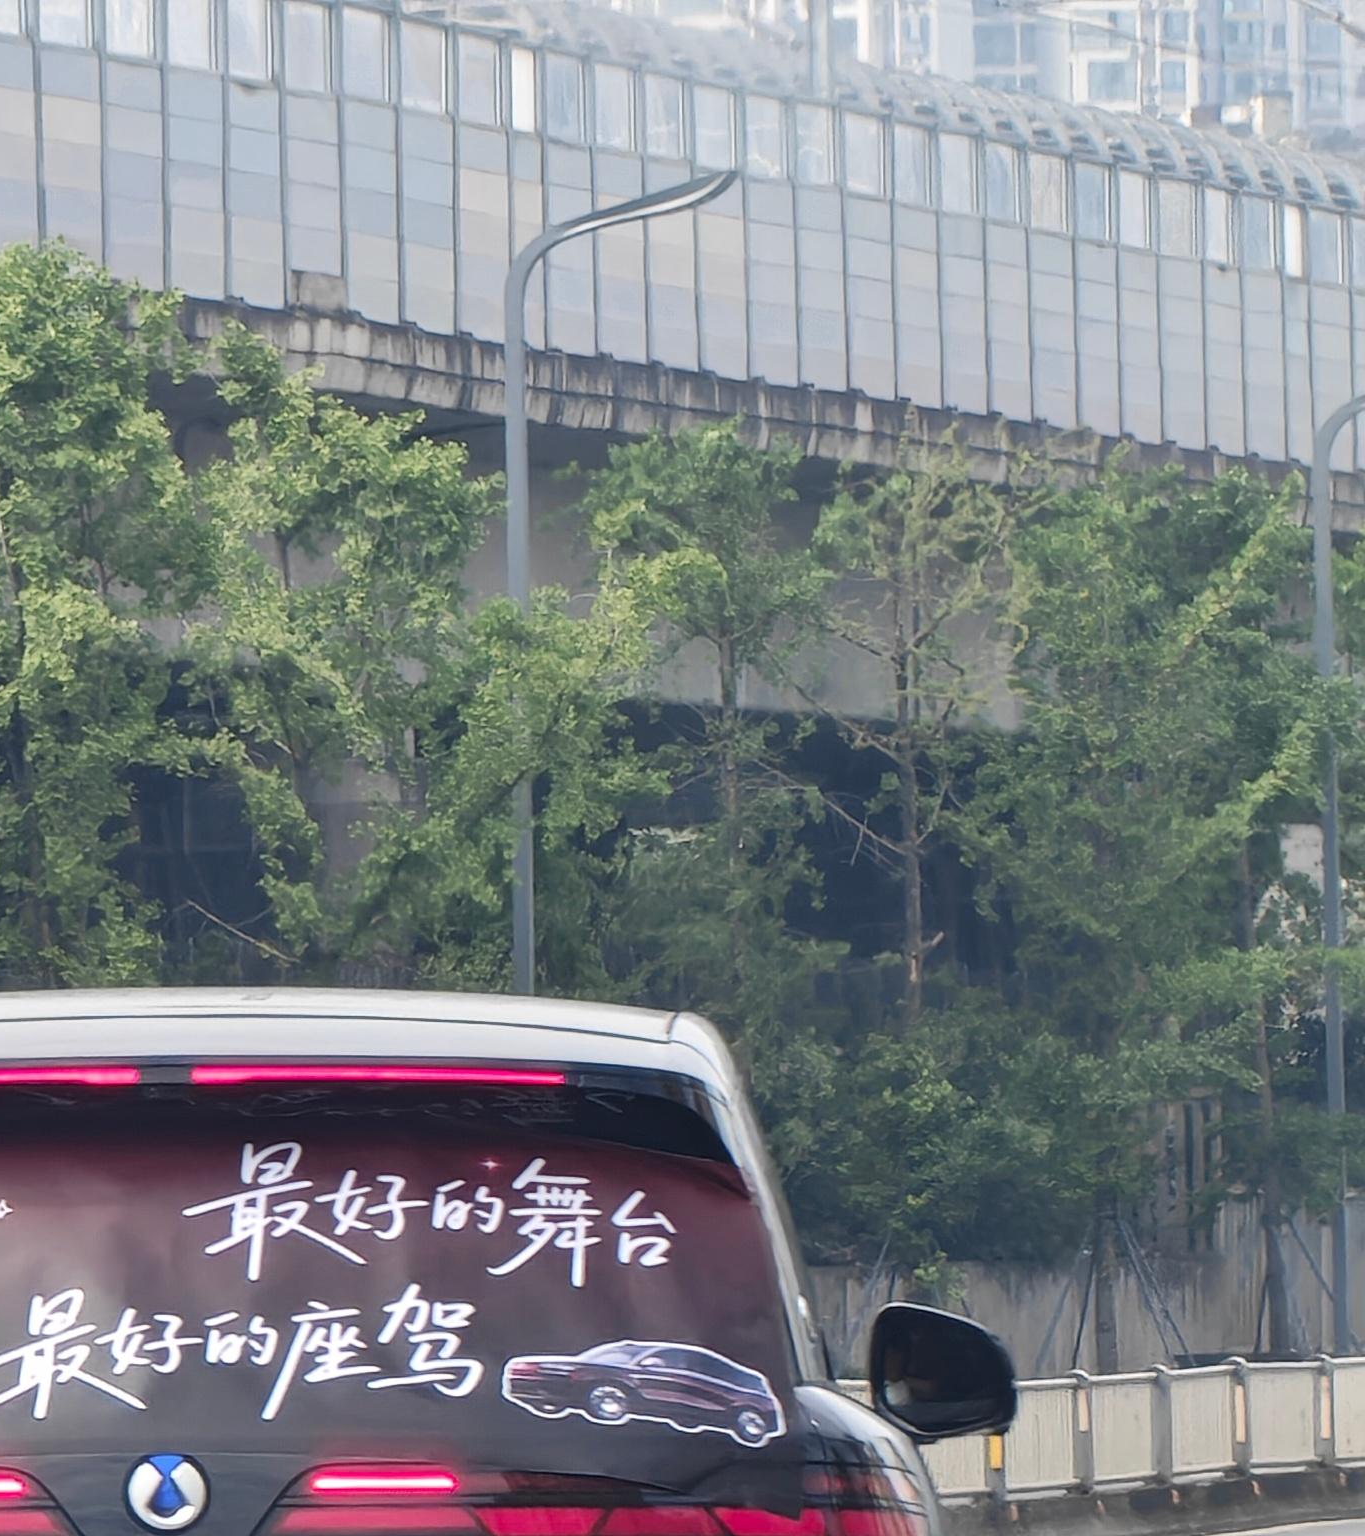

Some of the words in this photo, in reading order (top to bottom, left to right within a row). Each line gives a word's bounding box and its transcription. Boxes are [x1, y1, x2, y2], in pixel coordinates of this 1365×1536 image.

[182, 1142, 677, 1287] 最好的舞台
